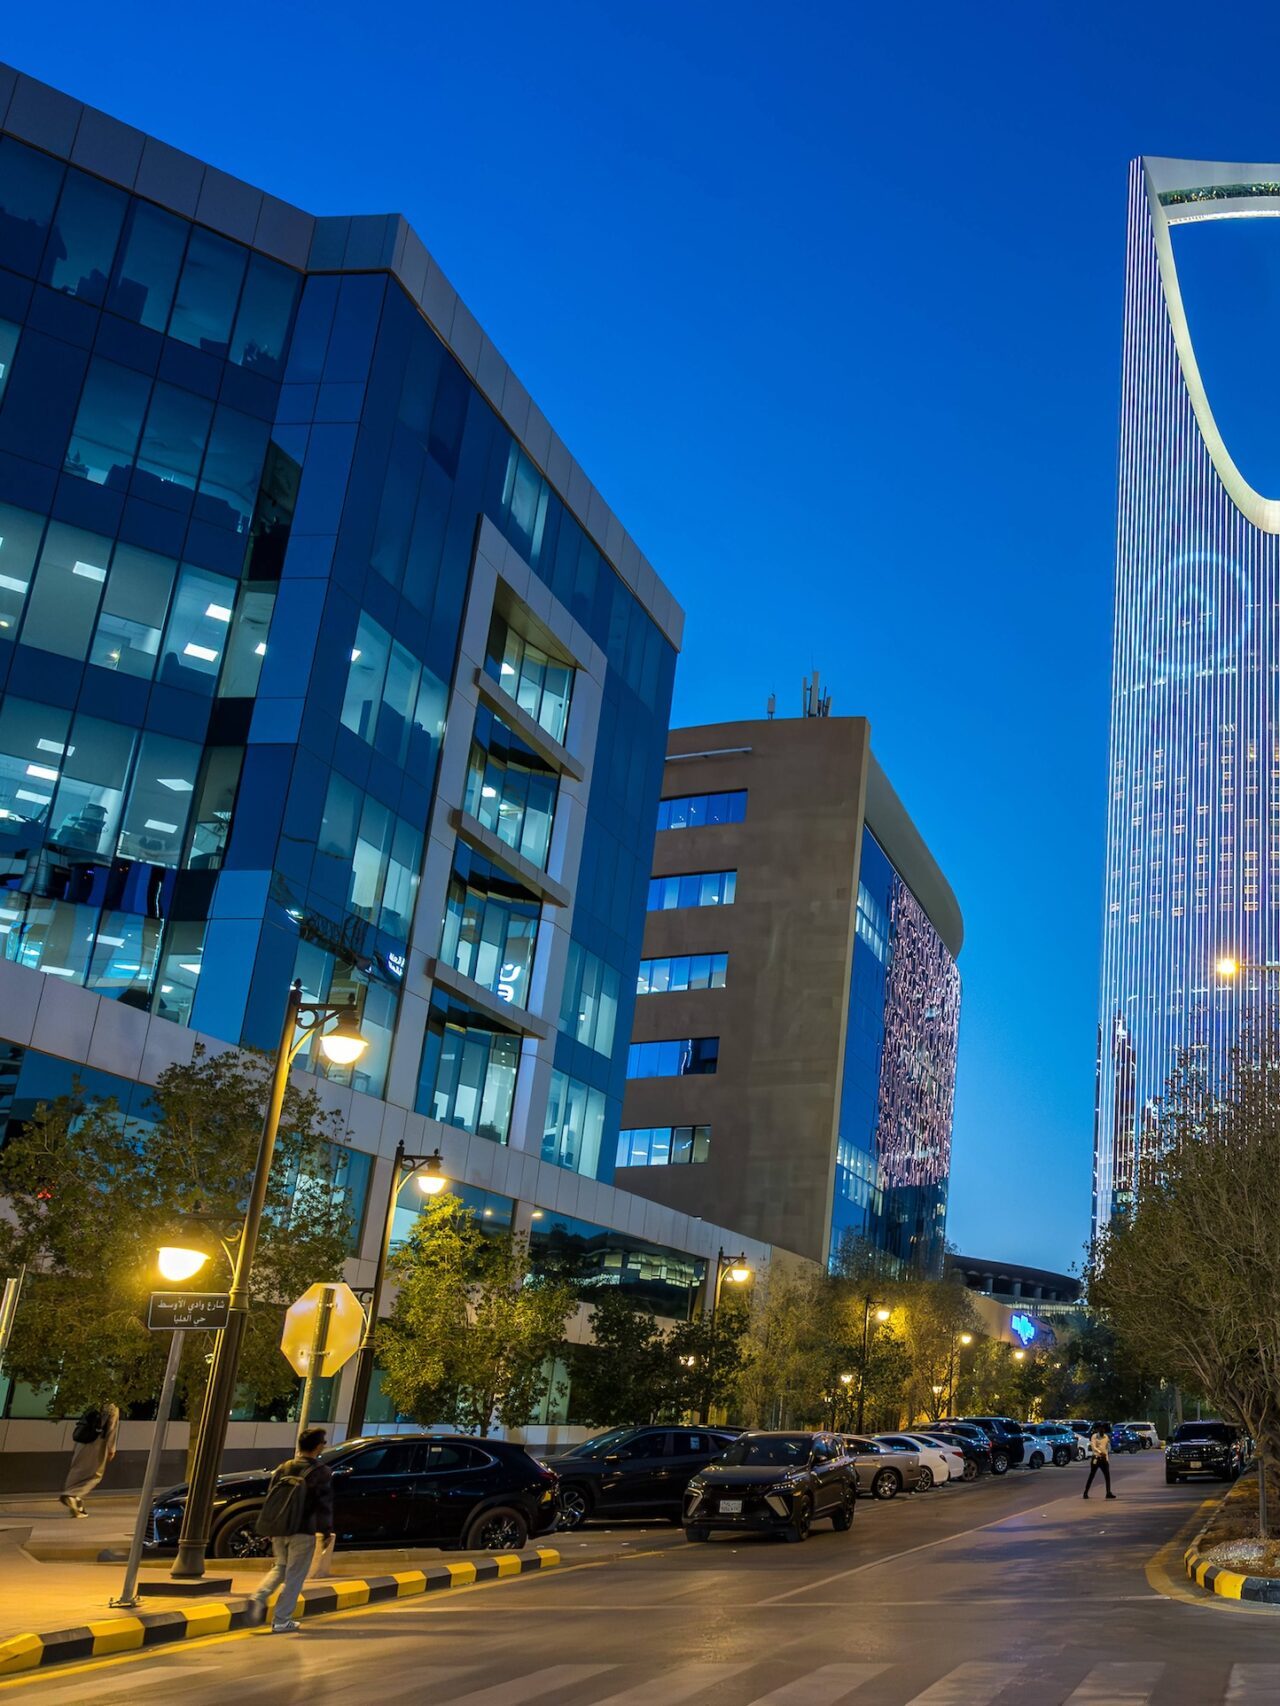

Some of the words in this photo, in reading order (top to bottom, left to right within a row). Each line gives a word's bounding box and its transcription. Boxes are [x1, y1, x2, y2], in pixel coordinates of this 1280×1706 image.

[188, 1300, 204, 1313] وادي
[207, 1300, 225, 1311] شارع
[173, 1314, 191, 1324] العليا
[193, 1316, 206, 1326] حي
